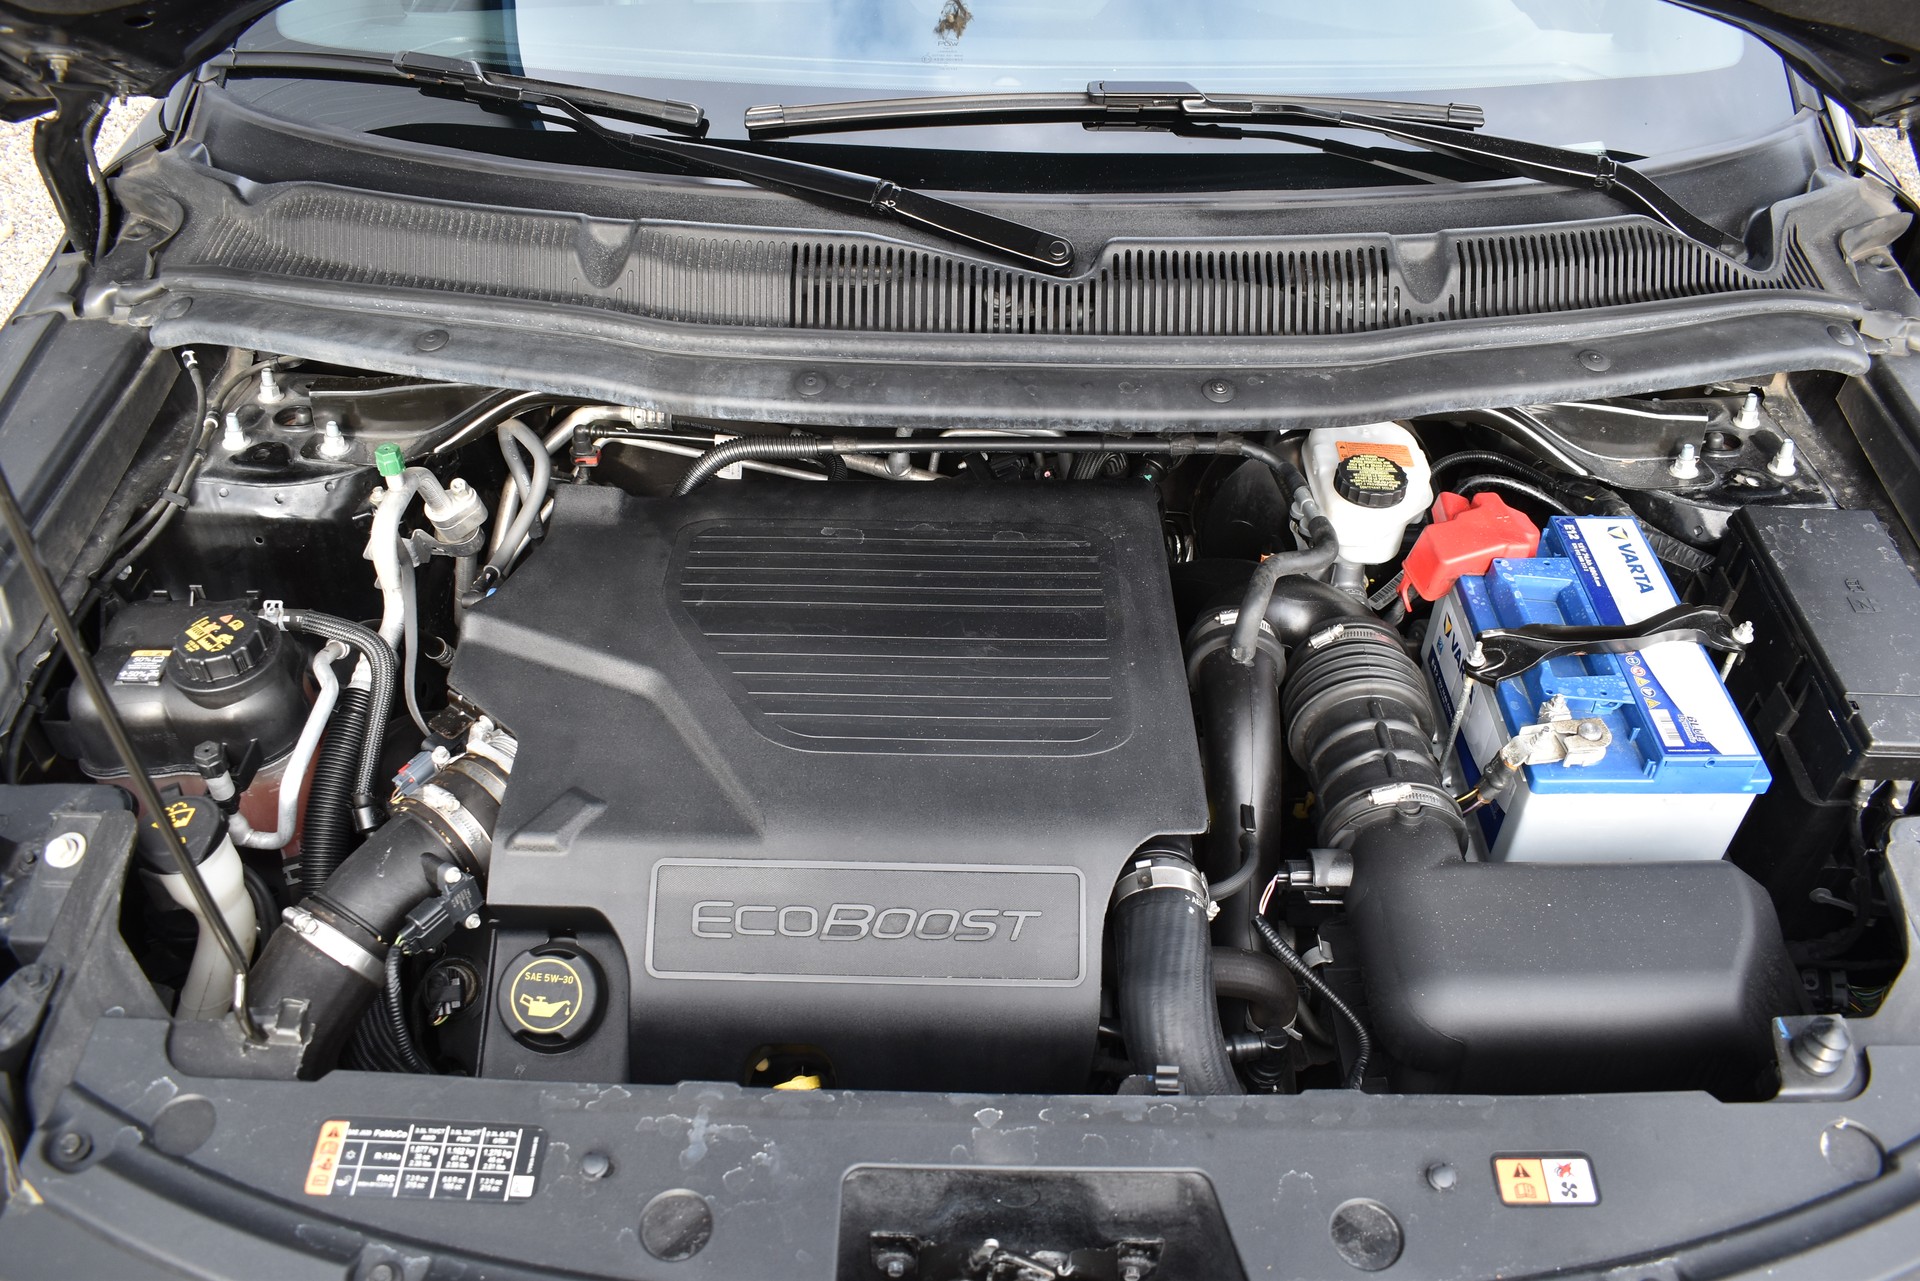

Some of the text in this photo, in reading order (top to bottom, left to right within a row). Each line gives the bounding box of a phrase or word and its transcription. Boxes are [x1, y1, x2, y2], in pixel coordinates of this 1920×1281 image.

[1564, 524, 1580, 540] E12
[1618, 543, 1654, 593] VARTA
[1687, 716, 1707, 741] BLUE
[525, 972, 574, 984] SAE 5W-30
[373, 1129, 408, 1138] FoMoCo
[374, 1152, 401, 1160] R-134a
